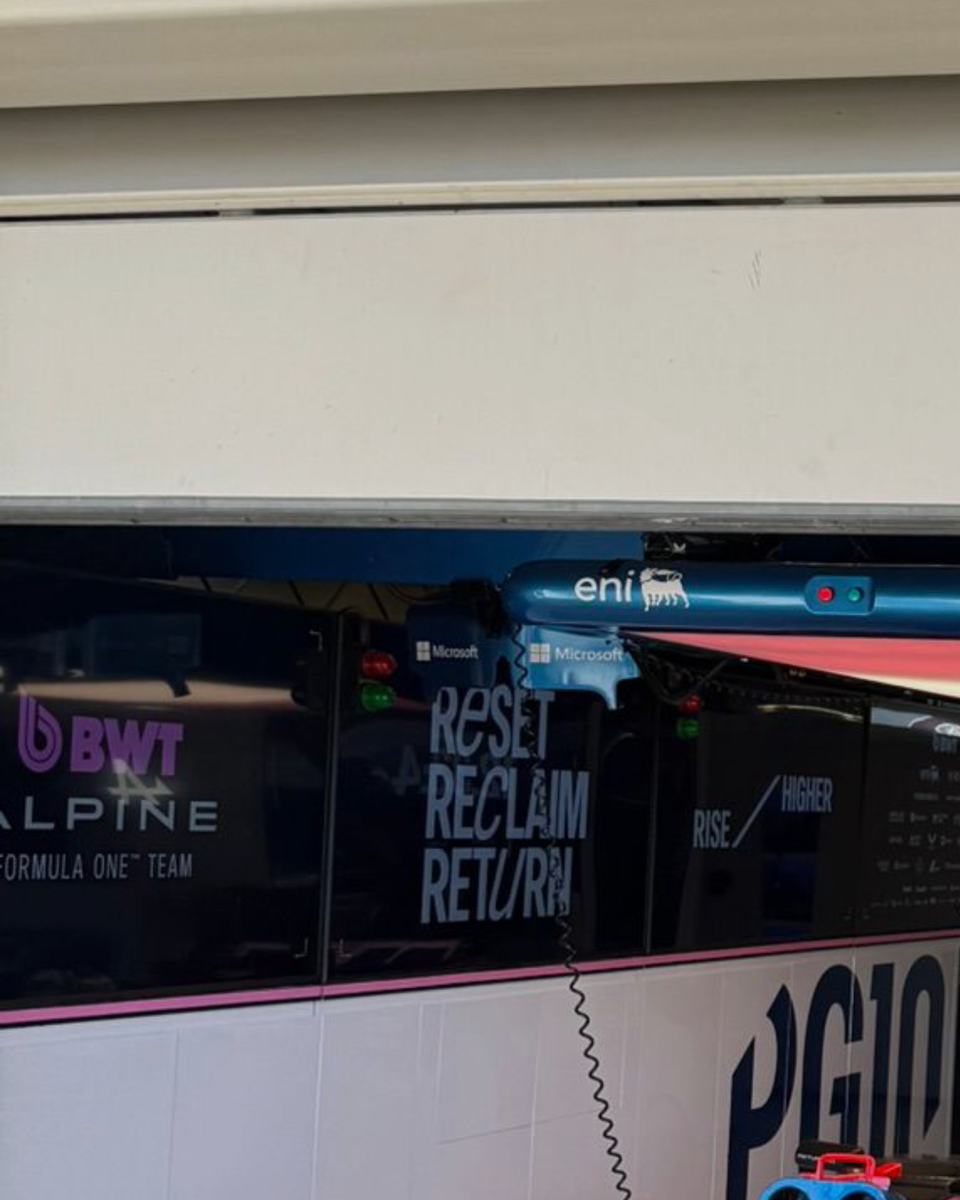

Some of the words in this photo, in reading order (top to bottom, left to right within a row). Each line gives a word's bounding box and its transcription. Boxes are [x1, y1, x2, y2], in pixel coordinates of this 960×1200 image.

[574, 570, 635, 602] eni
[433, 645, 478, 659] Microsoft
[555, 647, 622, 662] Microsoft
[70, 716, 183, 776] BWT
[425, 763, 590, 840] RECLAIM
[781, 775, 832, 813] HIGHER
[693, 809, 731, 848] RISE
[149, 853, 193, 878] TEAM
[420, 846, 573, 924] RETURN
